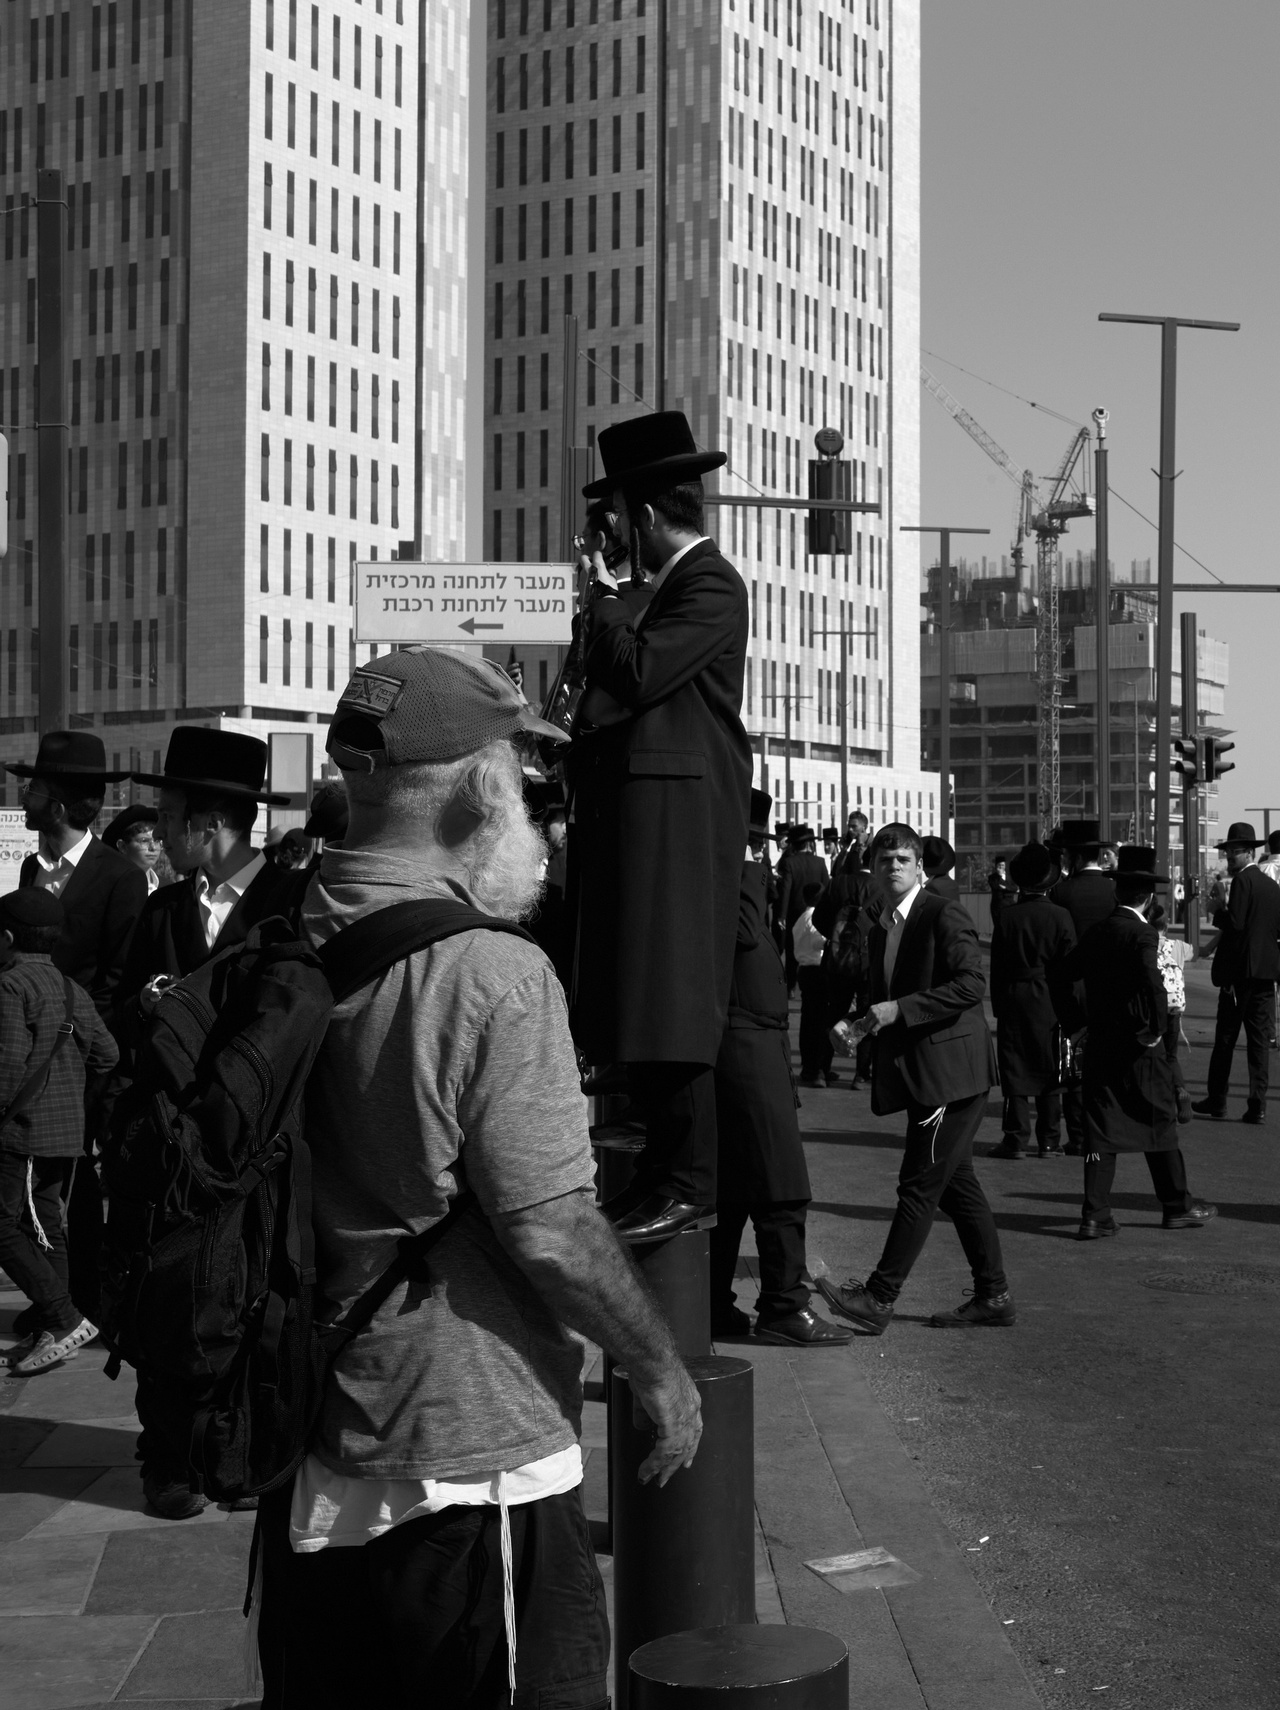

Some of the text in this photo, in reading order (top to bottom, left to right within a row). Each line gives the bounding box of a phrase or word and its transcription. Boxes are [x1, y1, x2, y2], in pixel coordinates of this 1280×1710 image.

[366, 572, 566, 591] מעבר לתחנה מרכזית
[382, 595, 566, 613] מעבר לתחנת רכבת
